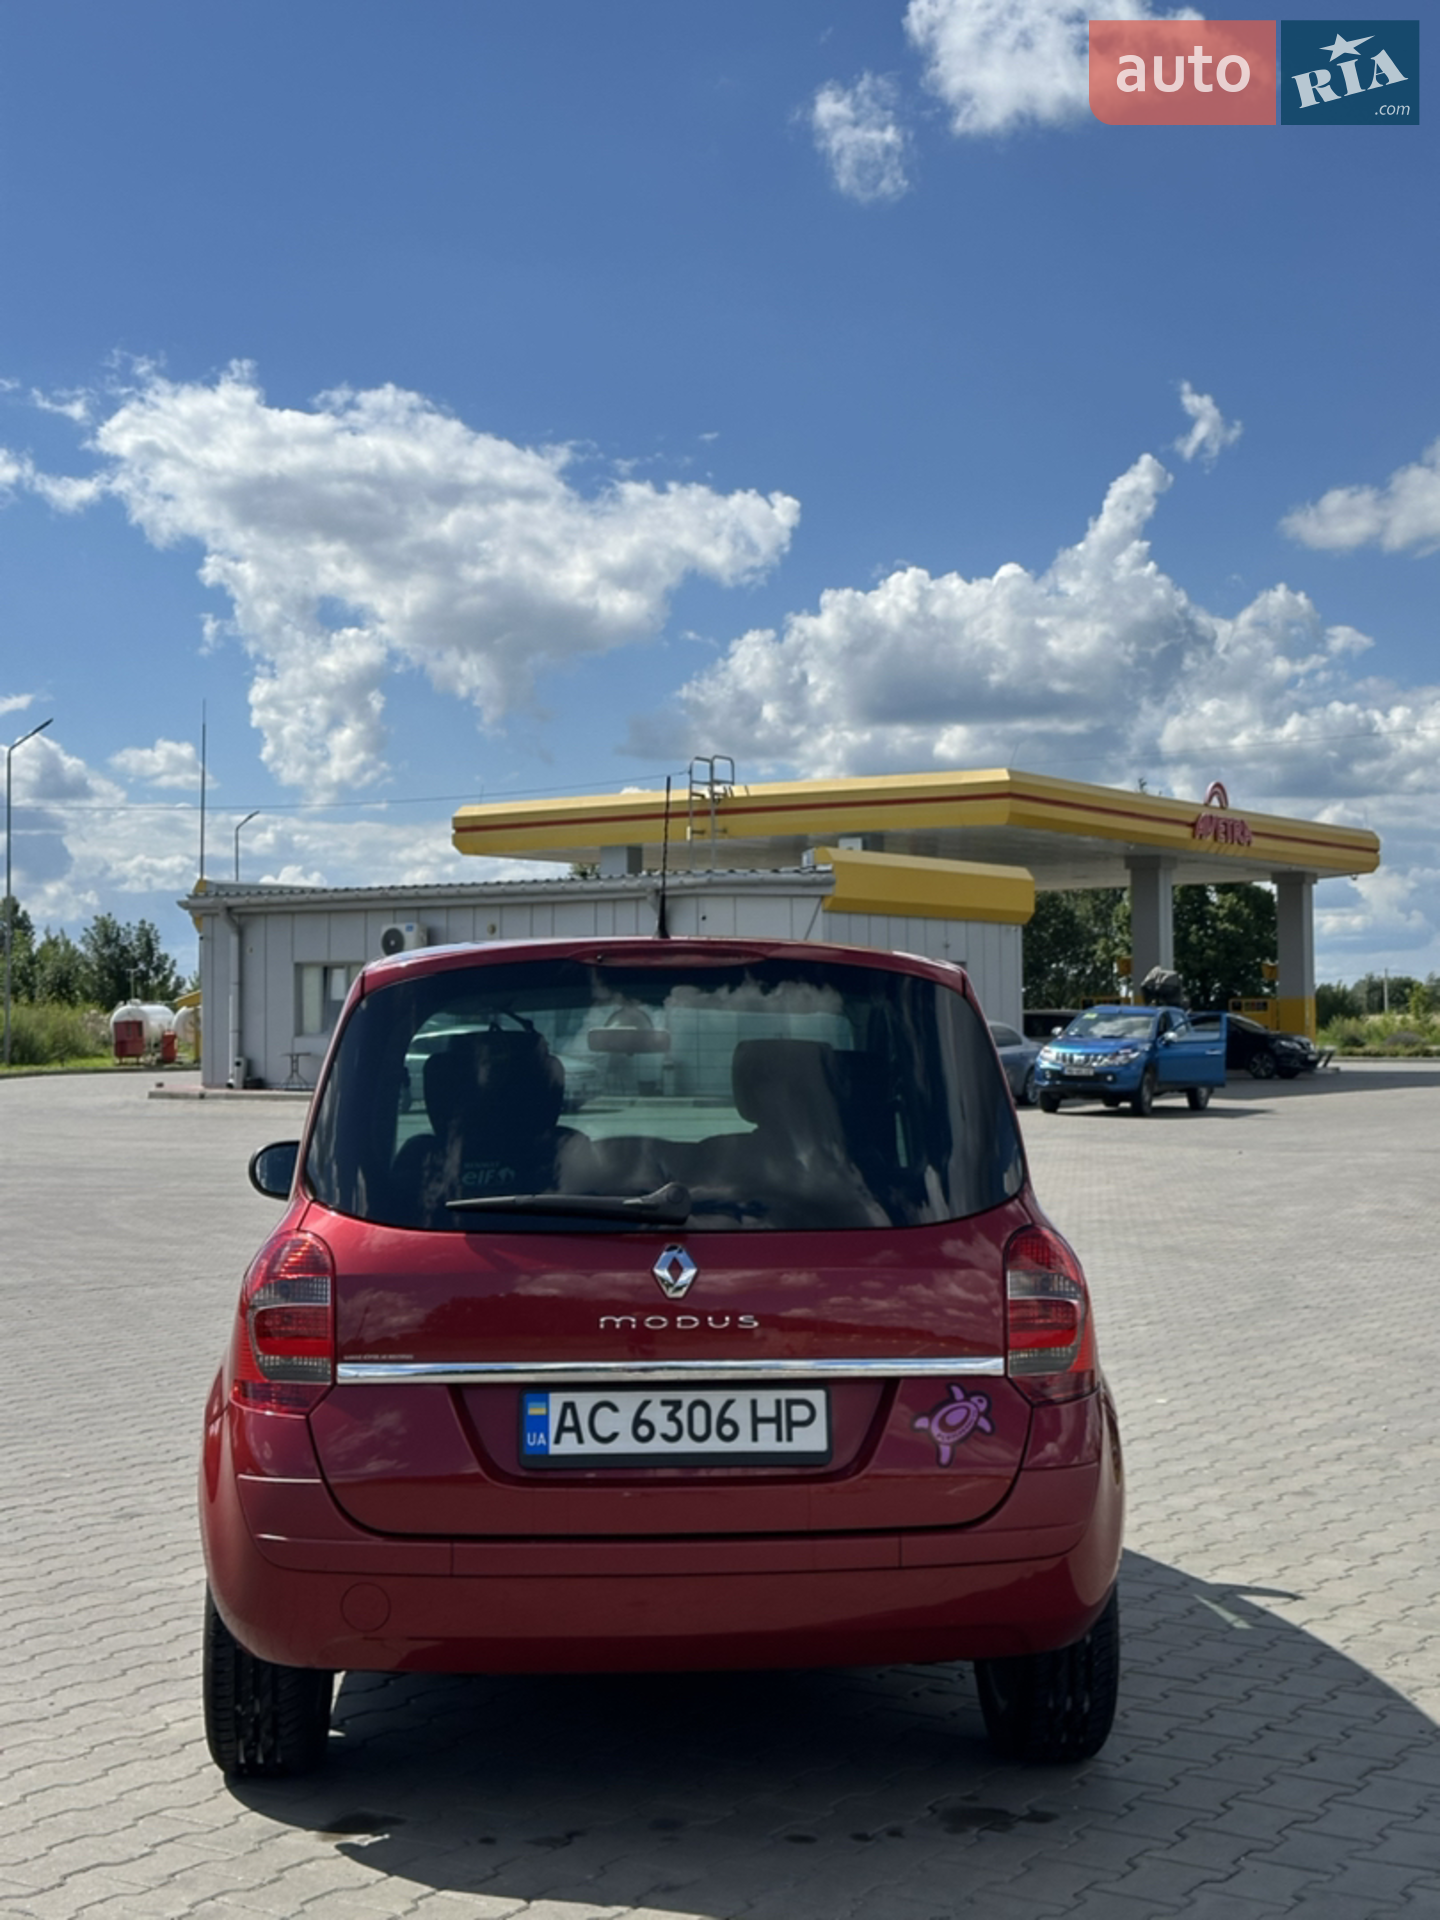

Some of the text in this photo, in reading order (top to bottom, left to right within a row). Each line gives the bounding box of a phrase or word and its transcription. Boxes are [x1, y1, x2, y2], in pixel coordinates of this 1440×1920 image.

[599, 1315, 759, 1329] MODUS
[553, 1398, 817, 1445] AC 6306 HP
[527, 1432, 547, 1446] UA
